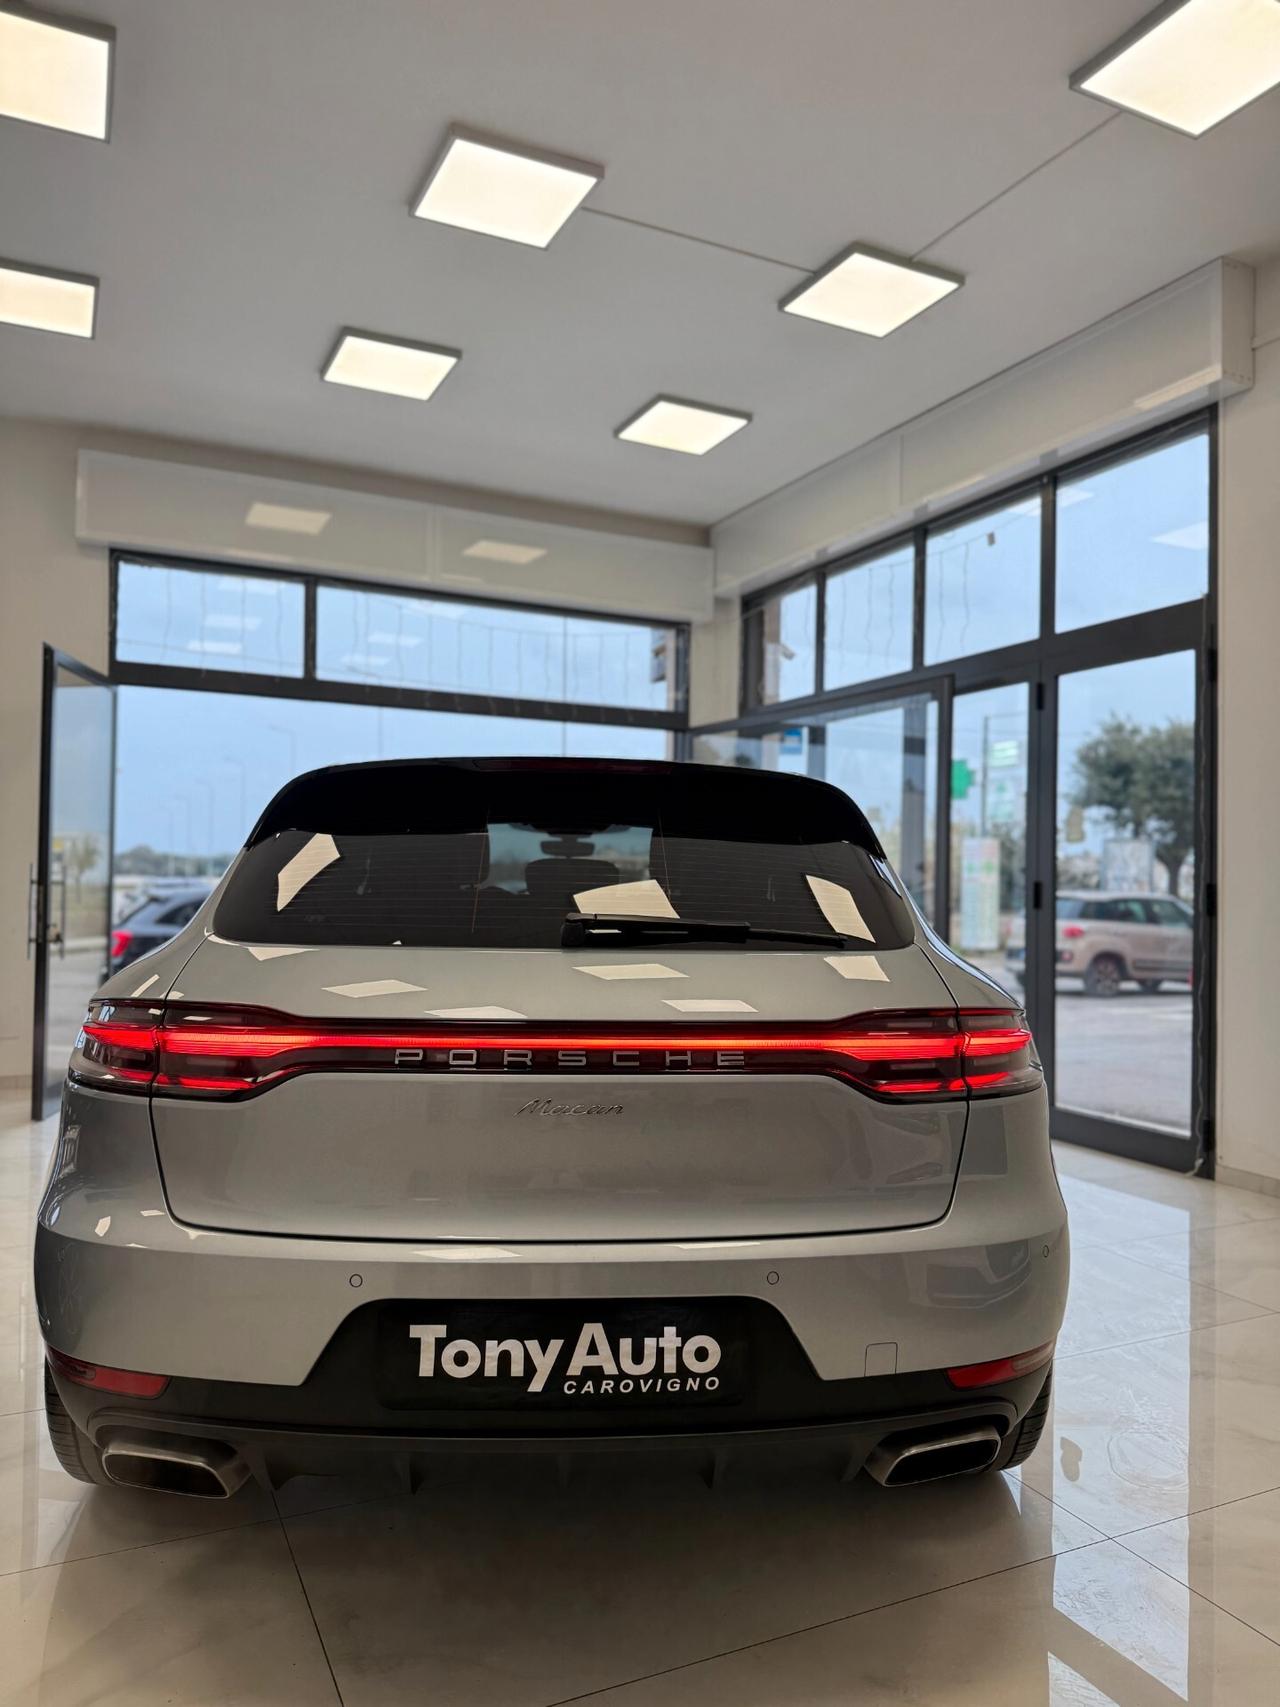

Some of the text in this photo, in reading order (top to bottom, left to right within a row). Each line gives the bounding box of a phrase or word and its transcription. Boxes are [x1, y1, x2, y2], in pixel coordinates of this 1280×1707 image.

[394, 1049, 745, 1066] PORSCHE
[513, 1098, 624, 1117] Macan
[409, 1322, 722, 1392] Tony Auto
[563, 1376, 720, 1394] CAROVIGNO
